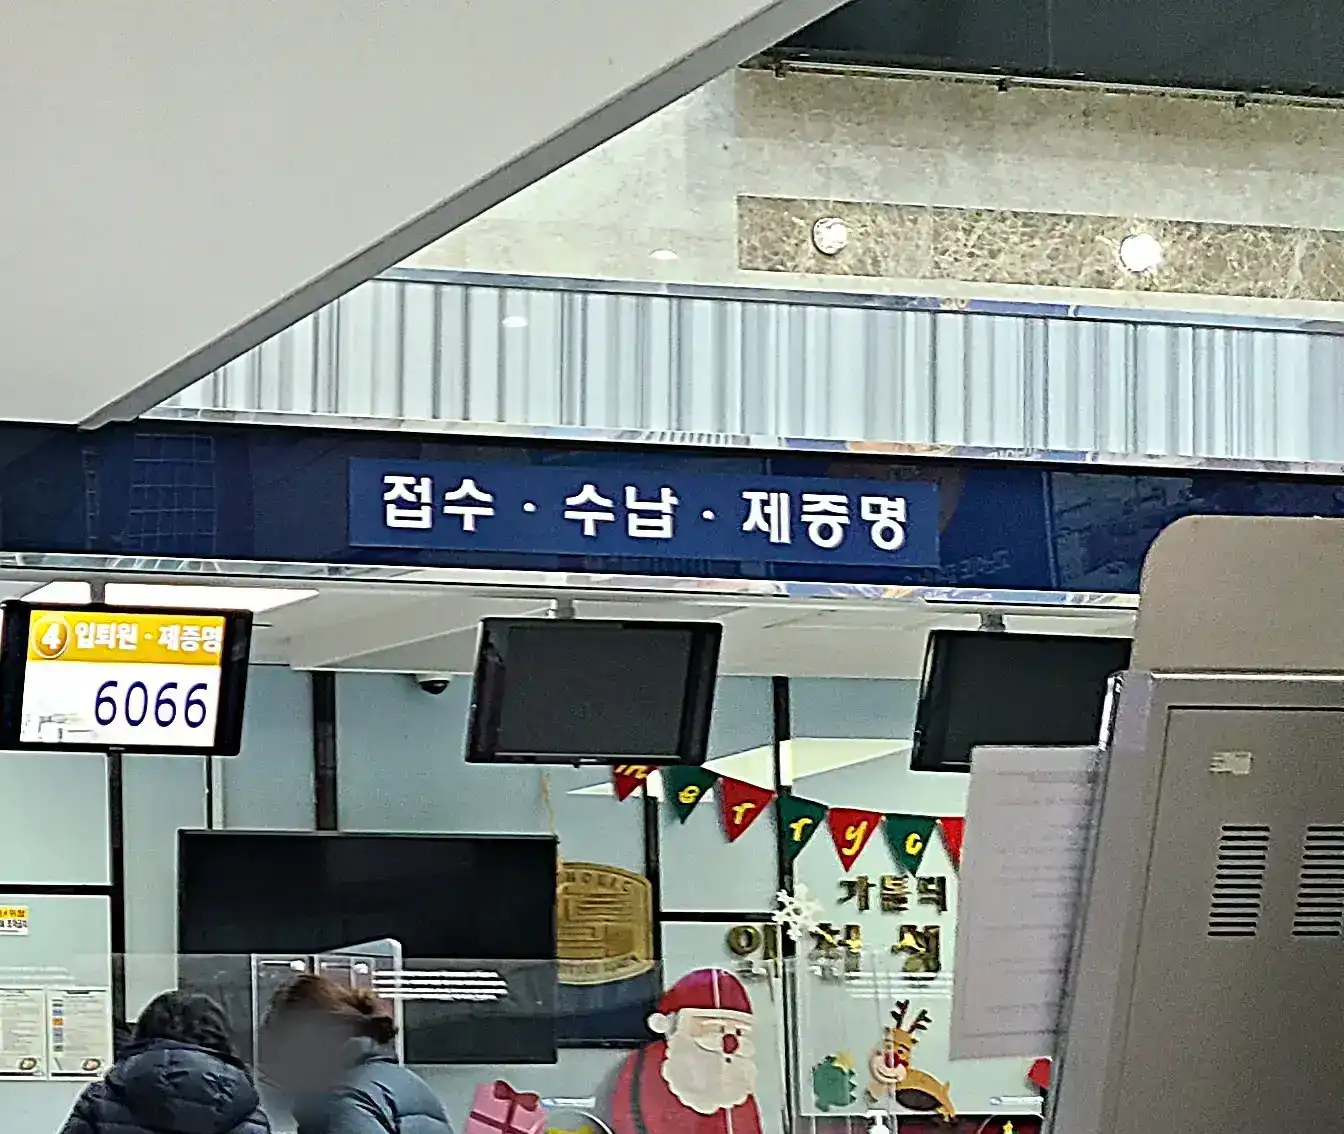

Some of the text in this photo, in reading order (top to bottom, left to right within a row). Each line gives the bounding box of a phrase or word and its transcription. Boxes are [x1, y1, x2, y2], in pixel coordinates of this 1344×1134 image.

[383, 474, 906, 552] 접수 수납 제증명
[40, 621, 223, 654] 4 입퇴원 제증명
[94, 680, 208, 728] 6066
